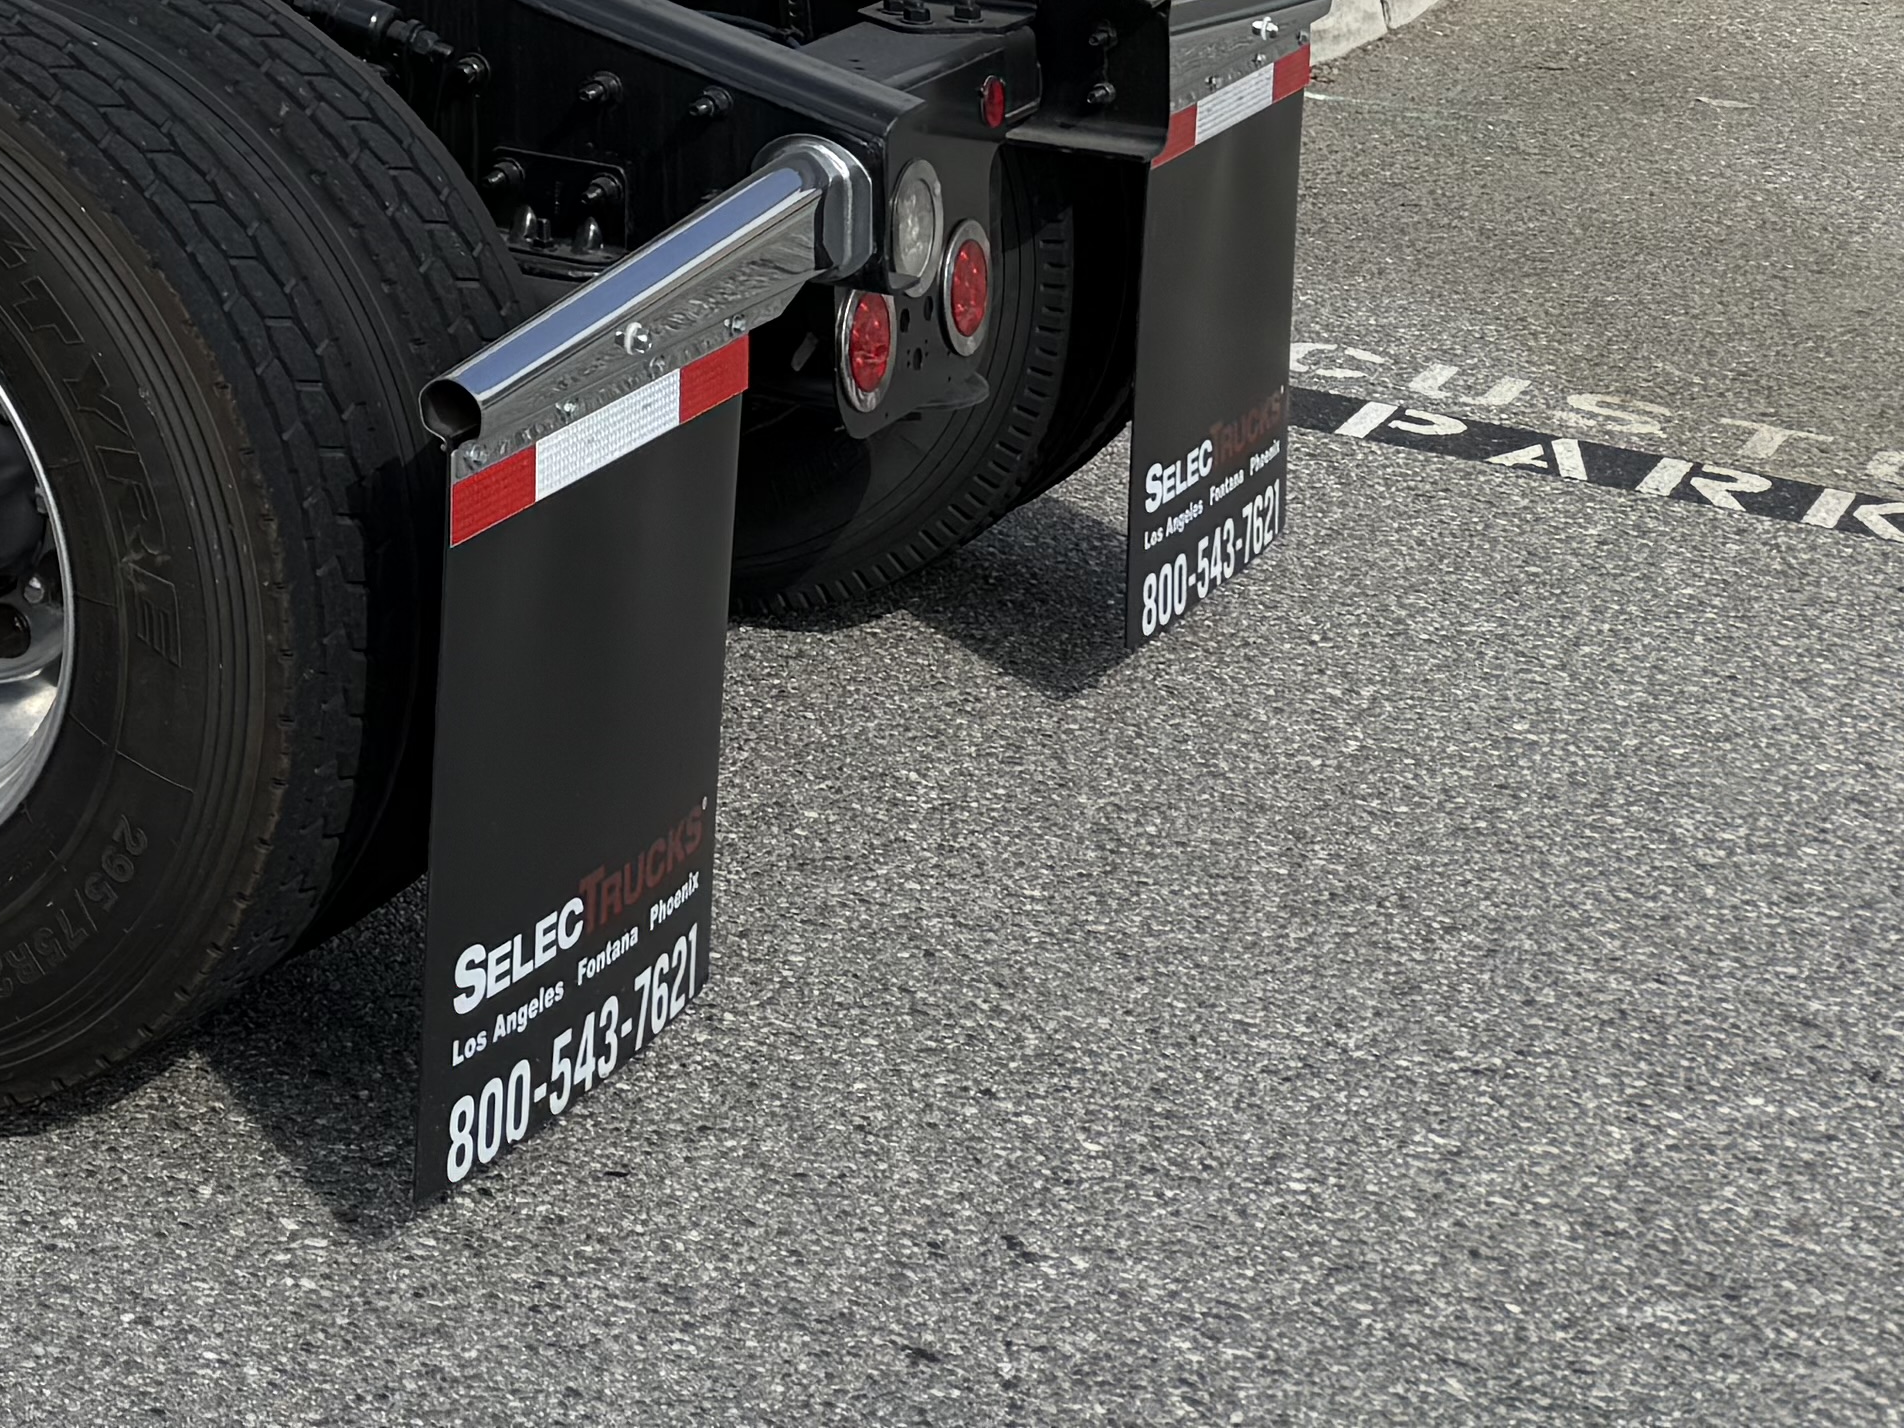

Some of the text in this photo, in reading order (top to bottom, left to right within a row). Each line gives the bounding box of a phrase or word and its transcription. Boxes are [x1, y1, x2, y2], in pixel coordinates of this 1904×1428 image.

[1141, 478, 1280, 637] 800-543-7621
[451, 868, 701, 1068] Los Angeles Fontana Phoenix
[452, 806, 705, 1015] SELECTRUCKS
[446, 921, 699, 1184] 800-543-7621
